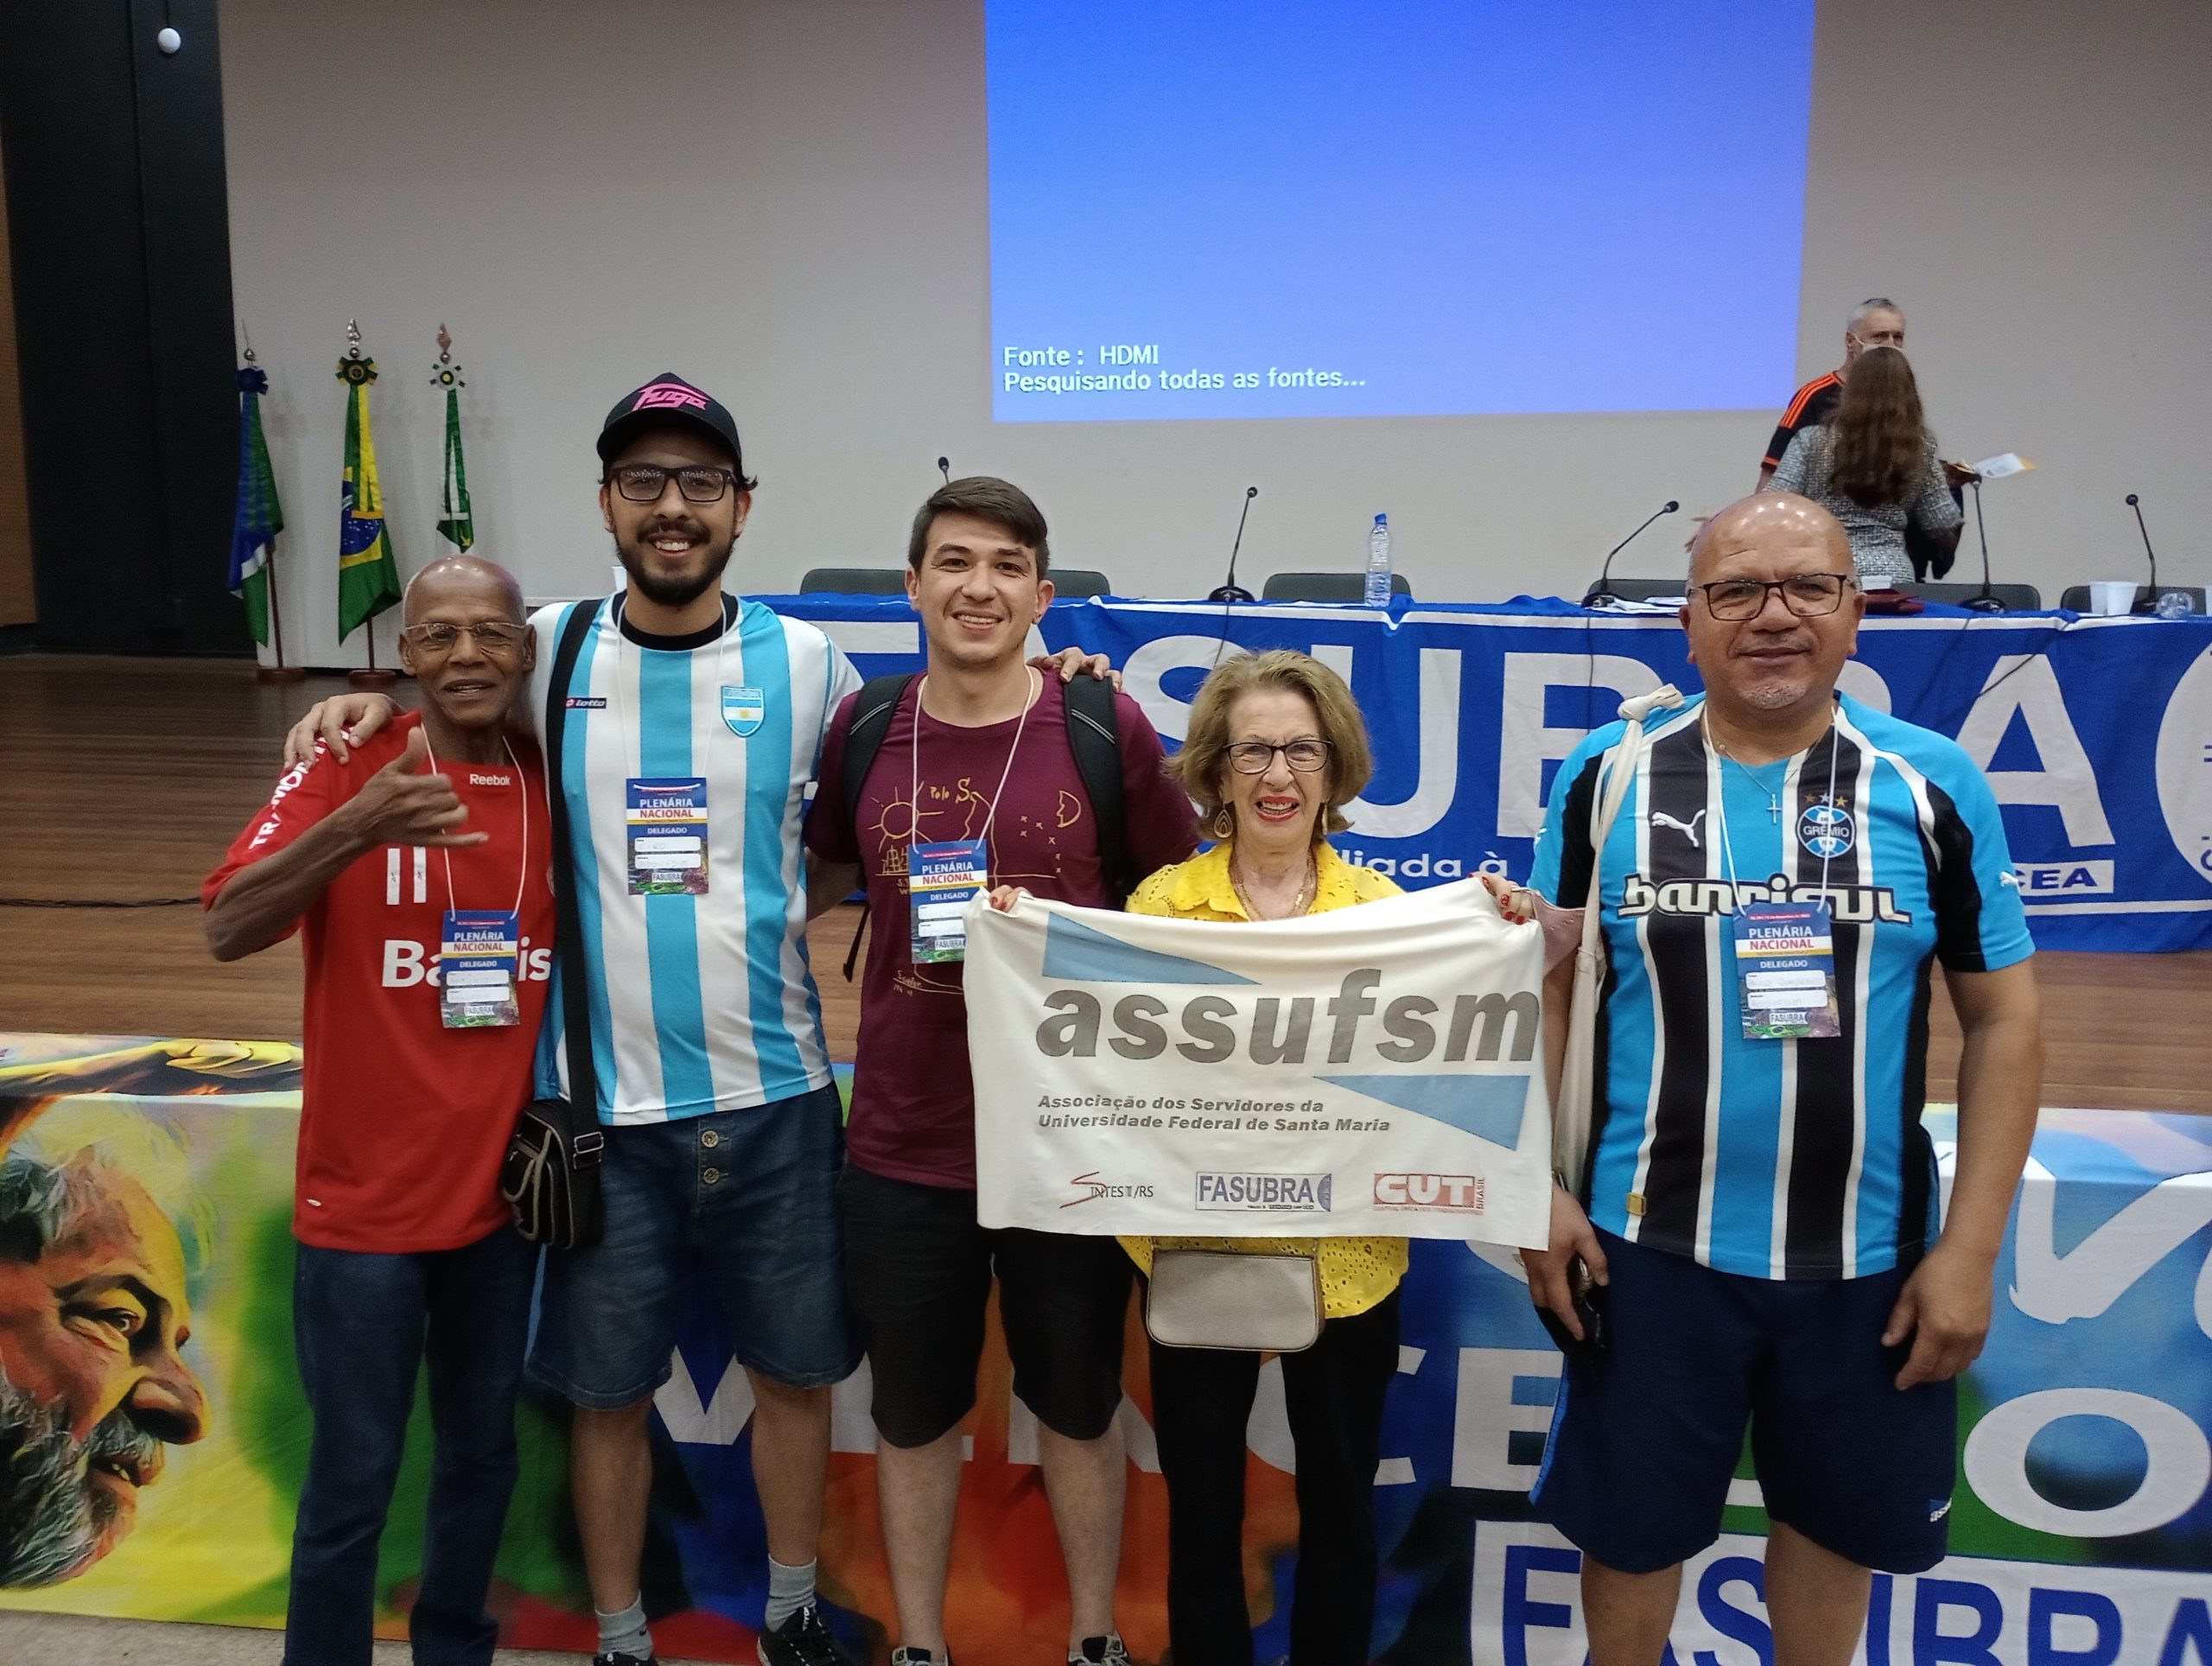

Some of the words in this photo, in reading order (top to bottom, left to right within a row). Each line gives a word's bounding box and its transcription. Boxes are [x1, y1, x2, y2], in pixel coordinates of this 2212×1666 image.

[1004, 346, 1071, 366] Fonte
[1099, 345, 1160, 366] HDMI
[1004, 370, 1152, 395] Pesquisando
[1159, 369, 1225, 390] todas
[1232, 372, 1260, 389] as
[1268, 366, 1365, 388] fontes...
[469, 773, 511, 786] Reebok
[639, 797, 694, 808] PLENÁRIA
[639, 809, 694, 818] NACIONAL
[1802, 823, 1850, 837] GRÊMIO
[922, 861, 974, 874] PLENÁRIA
[1335, 849, 1461, 877] liada
[1478, 851, 1508, 877] à
[922, 873, 974, 885] NACIONAL
[930, 892, 969, 900] DELEGADO
[454, 930, 505, 942] PLENÁRIA
[1748, 925, 1814, 938] PLENÁRIA
[454, 943, 504, 951] NACIONAL
[1750, 939, 1815, 951] NACIONAL
[1759, 960, 1808, 969] DELEGADO
[1035, 968, 1540, 1065] assufsm
[1038, 1095, 1147, 1110] Associação
[1152, 1097, 1186, 1110] dos
[1191, 1098, 1295, 1111] Servidores
[1300, 1100, 1324, 1112] da
[1039, 1114, 1163, 1128] Universidade
[1168, 1116, 1241, 1130] Federal
[1245, 1118, 1269, 1131] de
[1274, 1118, 1330, 1131] Santa
[1335, 1119, 1390, 1131] Maria
[1198, 1175, 1314, 1203] FASUBRA
[1375, 1174, 1474, 1206] CUT
